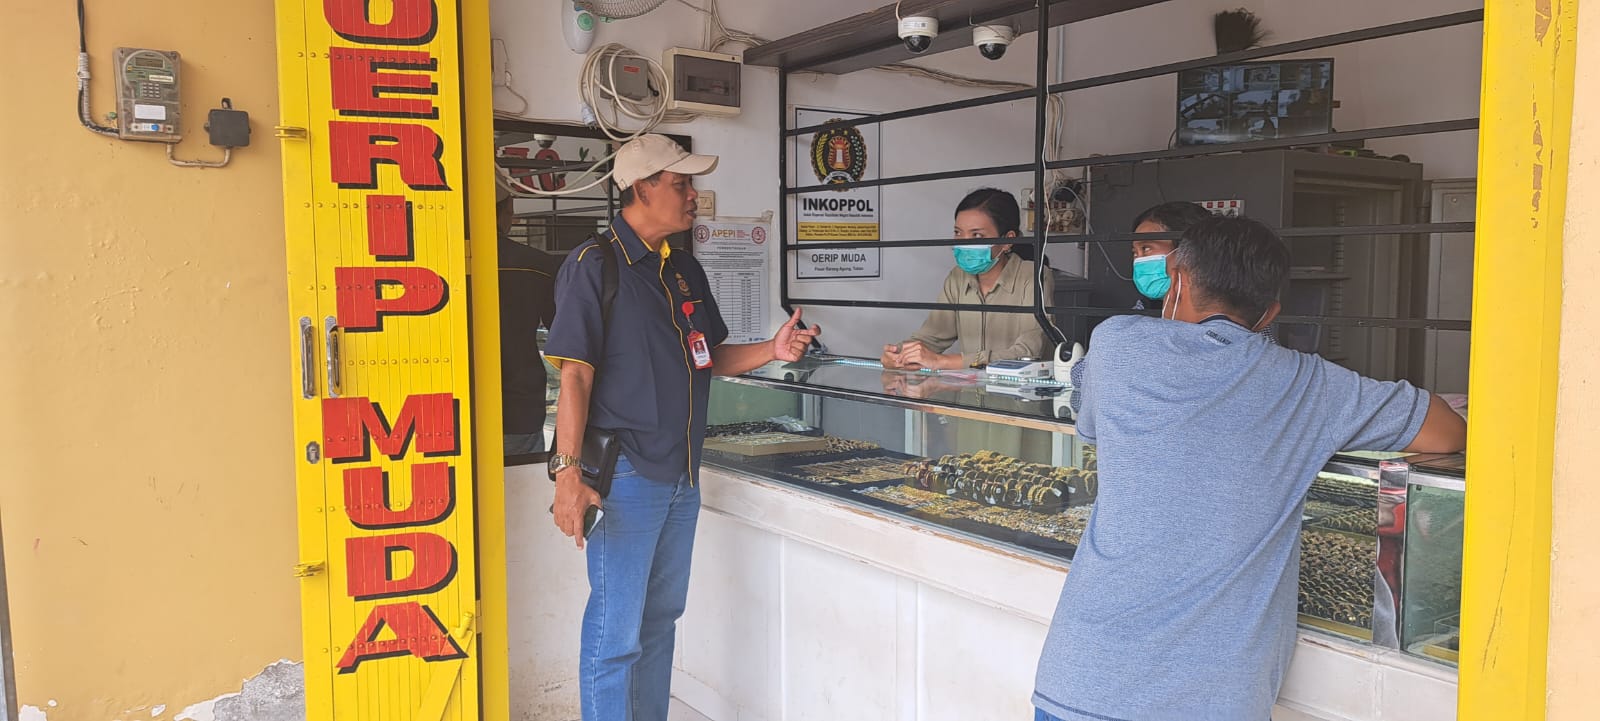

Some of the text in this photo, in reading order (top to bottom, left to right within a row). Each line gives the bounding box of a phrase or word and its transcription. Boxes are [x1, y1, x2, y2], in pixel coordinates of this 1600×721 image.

[803, 197, 874, 212] INKOPPOL
[711, 229, 736, 238] APEPI
[811, 253, 866, 263] OERIP MUDA
[323, 392, 468, 675] MUDA
